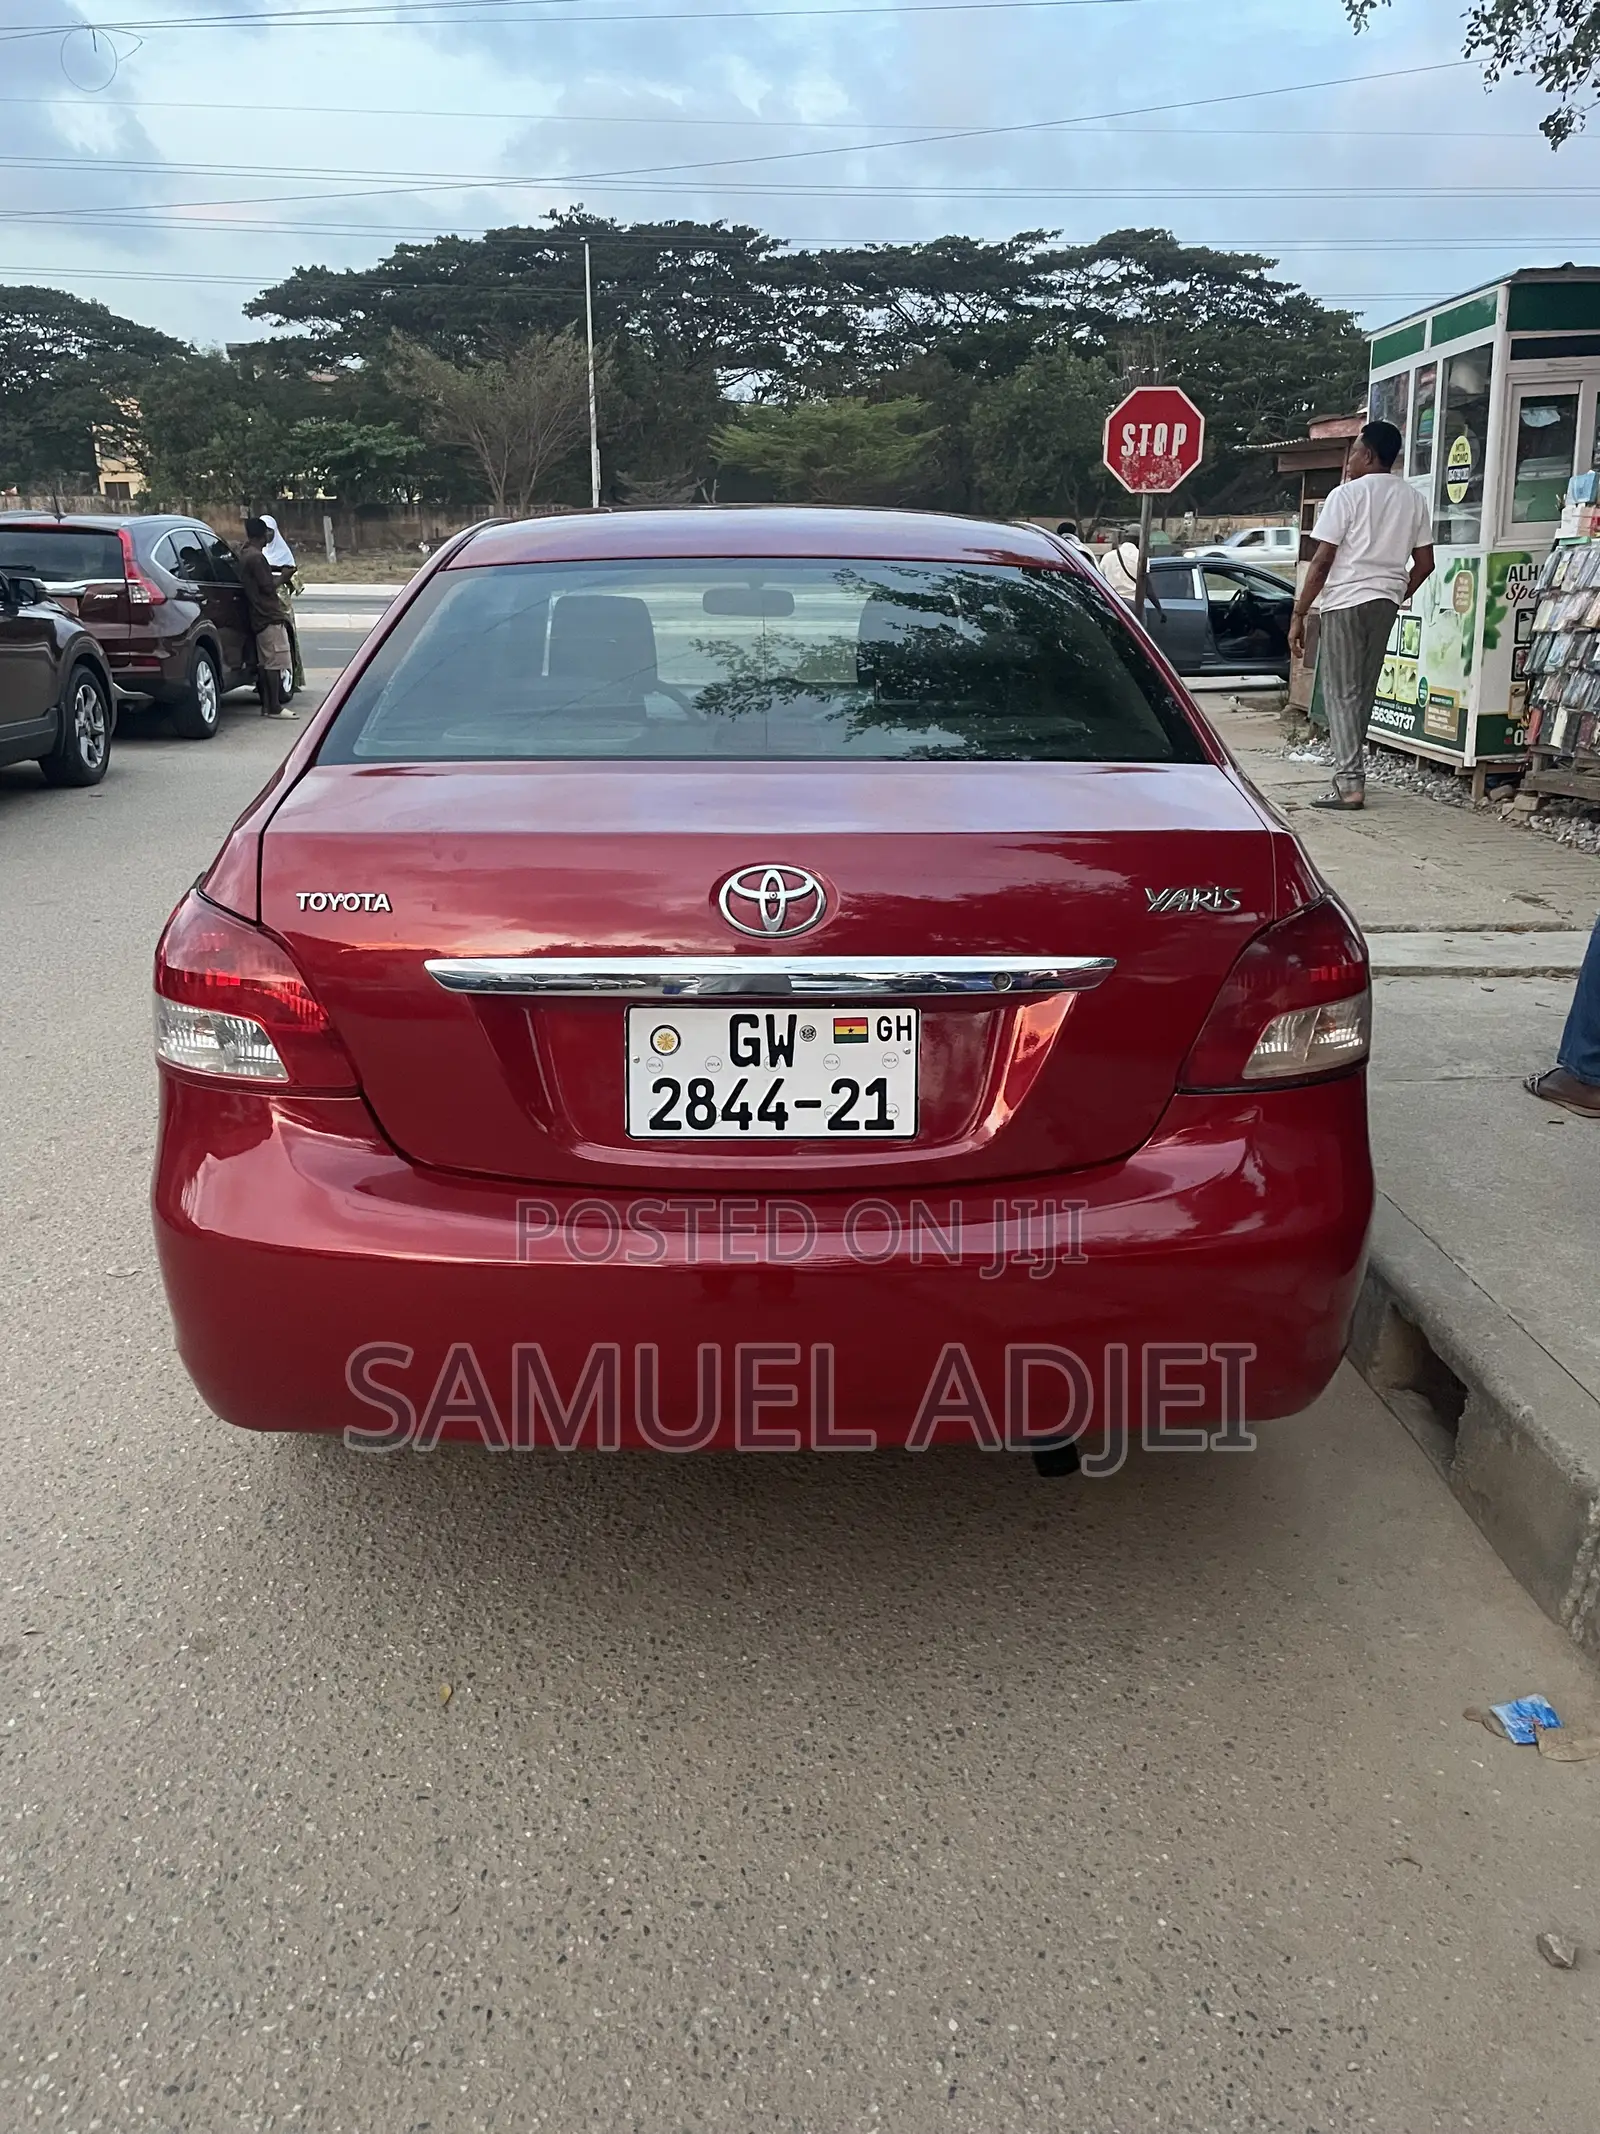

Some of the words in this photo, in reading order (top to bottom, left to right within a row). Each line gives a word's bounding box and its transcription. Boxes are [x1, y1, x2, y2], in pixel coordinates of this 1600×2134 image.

[1121, 423, 1187, 456] STOP
[296, 892, 393, 912] TOYOTA
[729, 1013, 797, 1068] GW
[876, 1015, 912, 1042] GH
[649, 1077, 895, 1131] 2844-21
